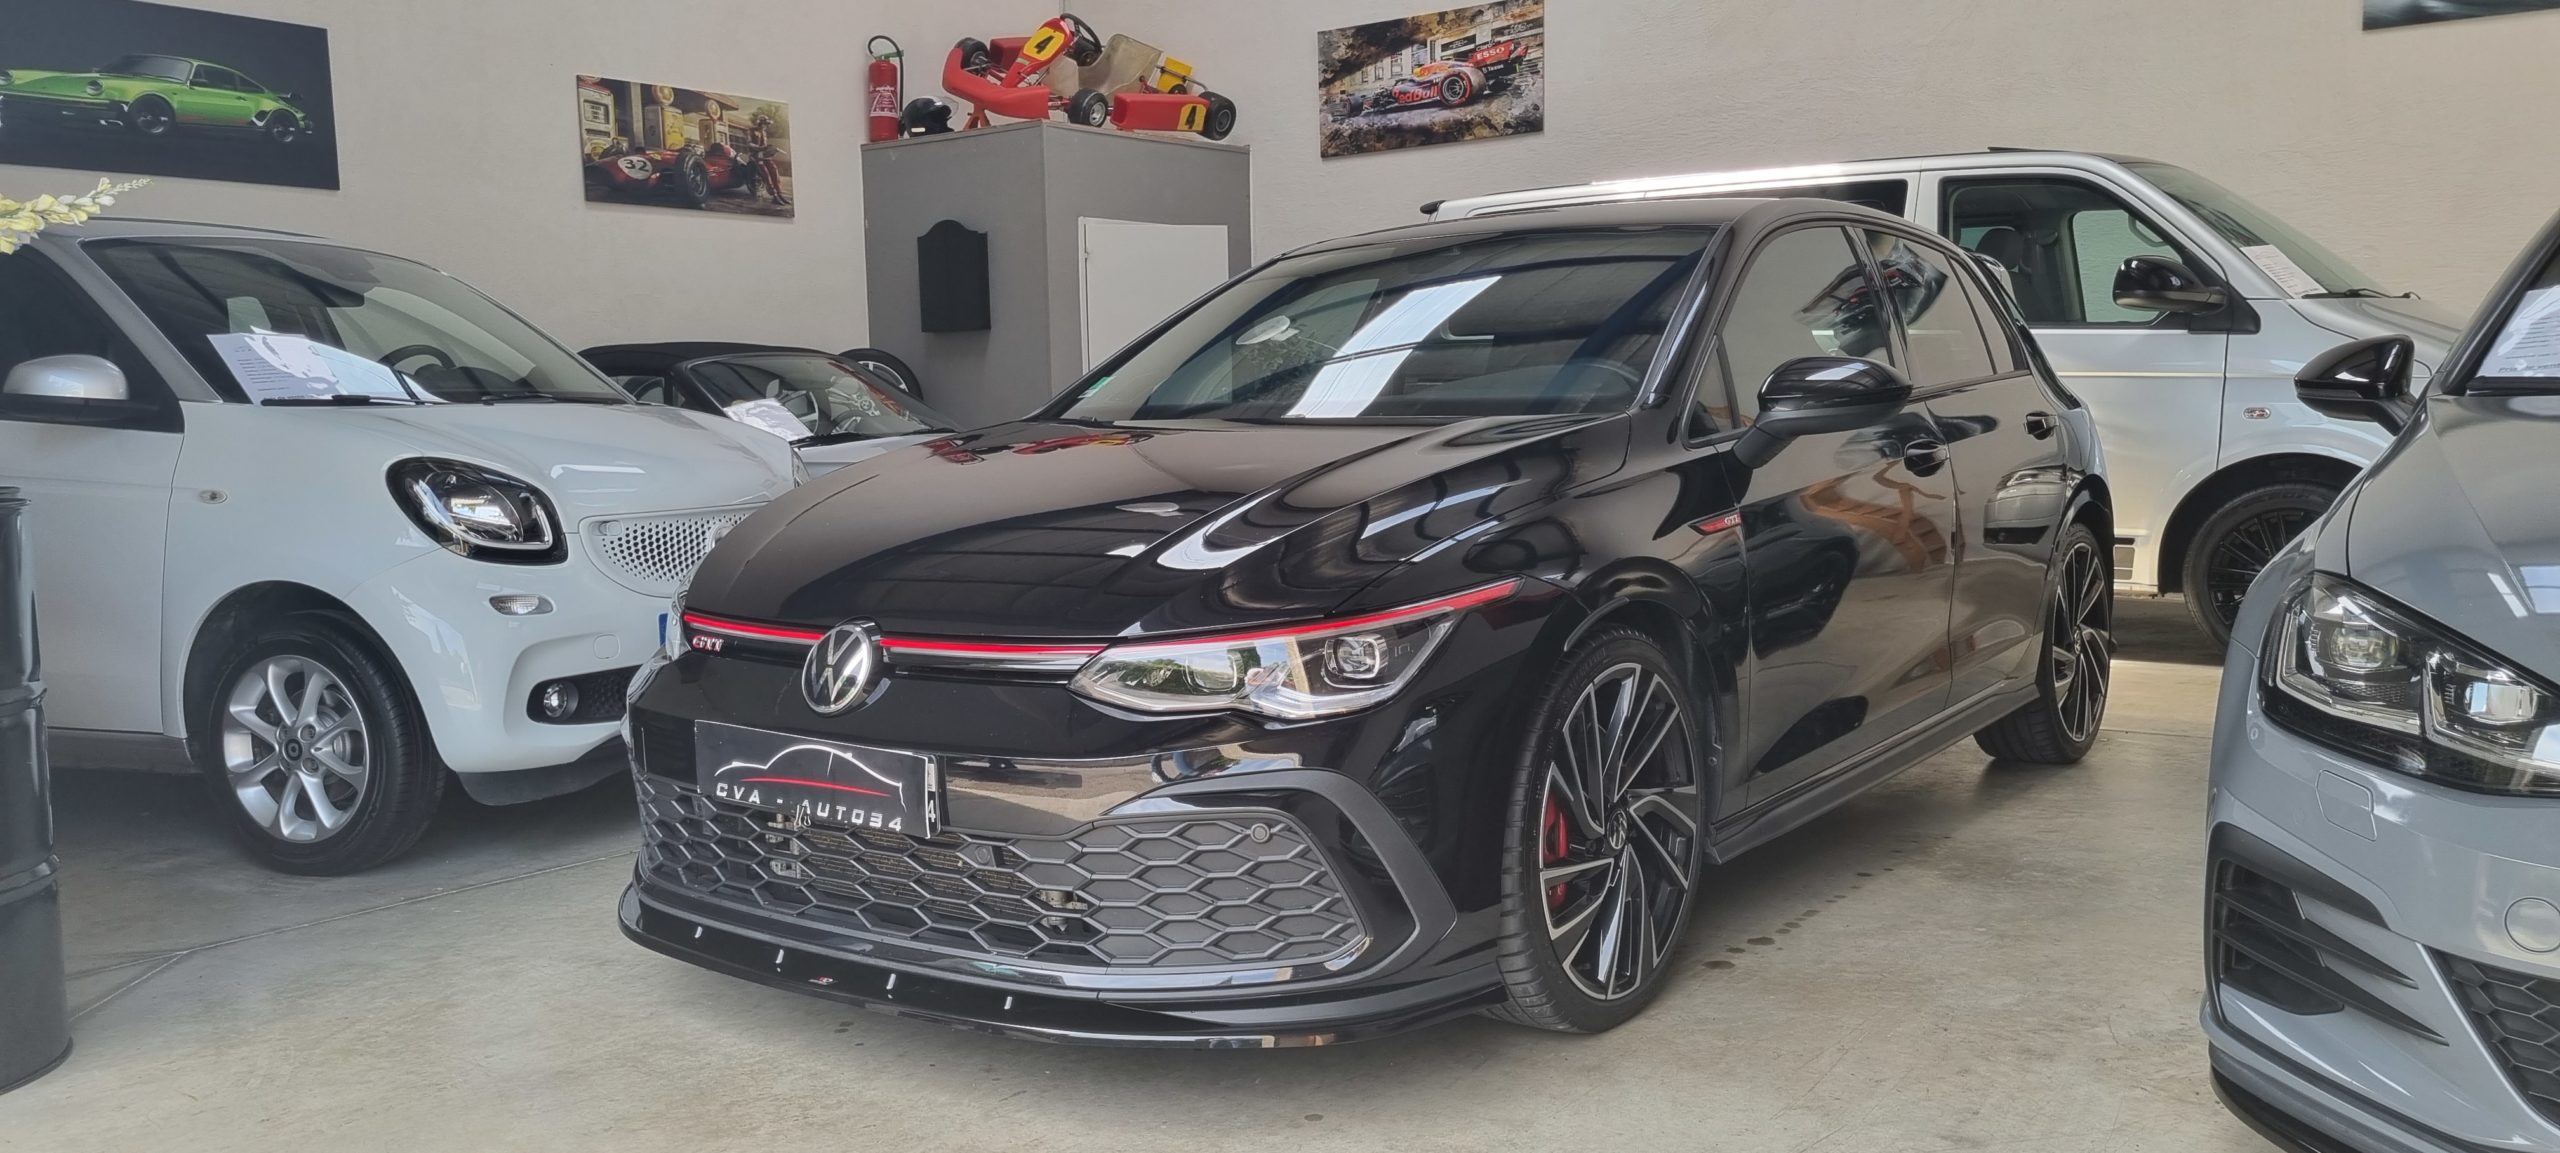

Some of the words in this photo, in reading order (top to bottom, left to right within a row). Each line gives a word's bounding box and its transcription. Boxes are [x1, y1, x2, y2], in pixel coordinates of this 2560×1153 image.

[1033, 34, 1055, 54] 4
[1476, 46, 1505, 59] ESSO
[1185, 105, 1198, 130] 4
[623, 158, 649, 173] 32
[716, 782, 761, 805] CVA
